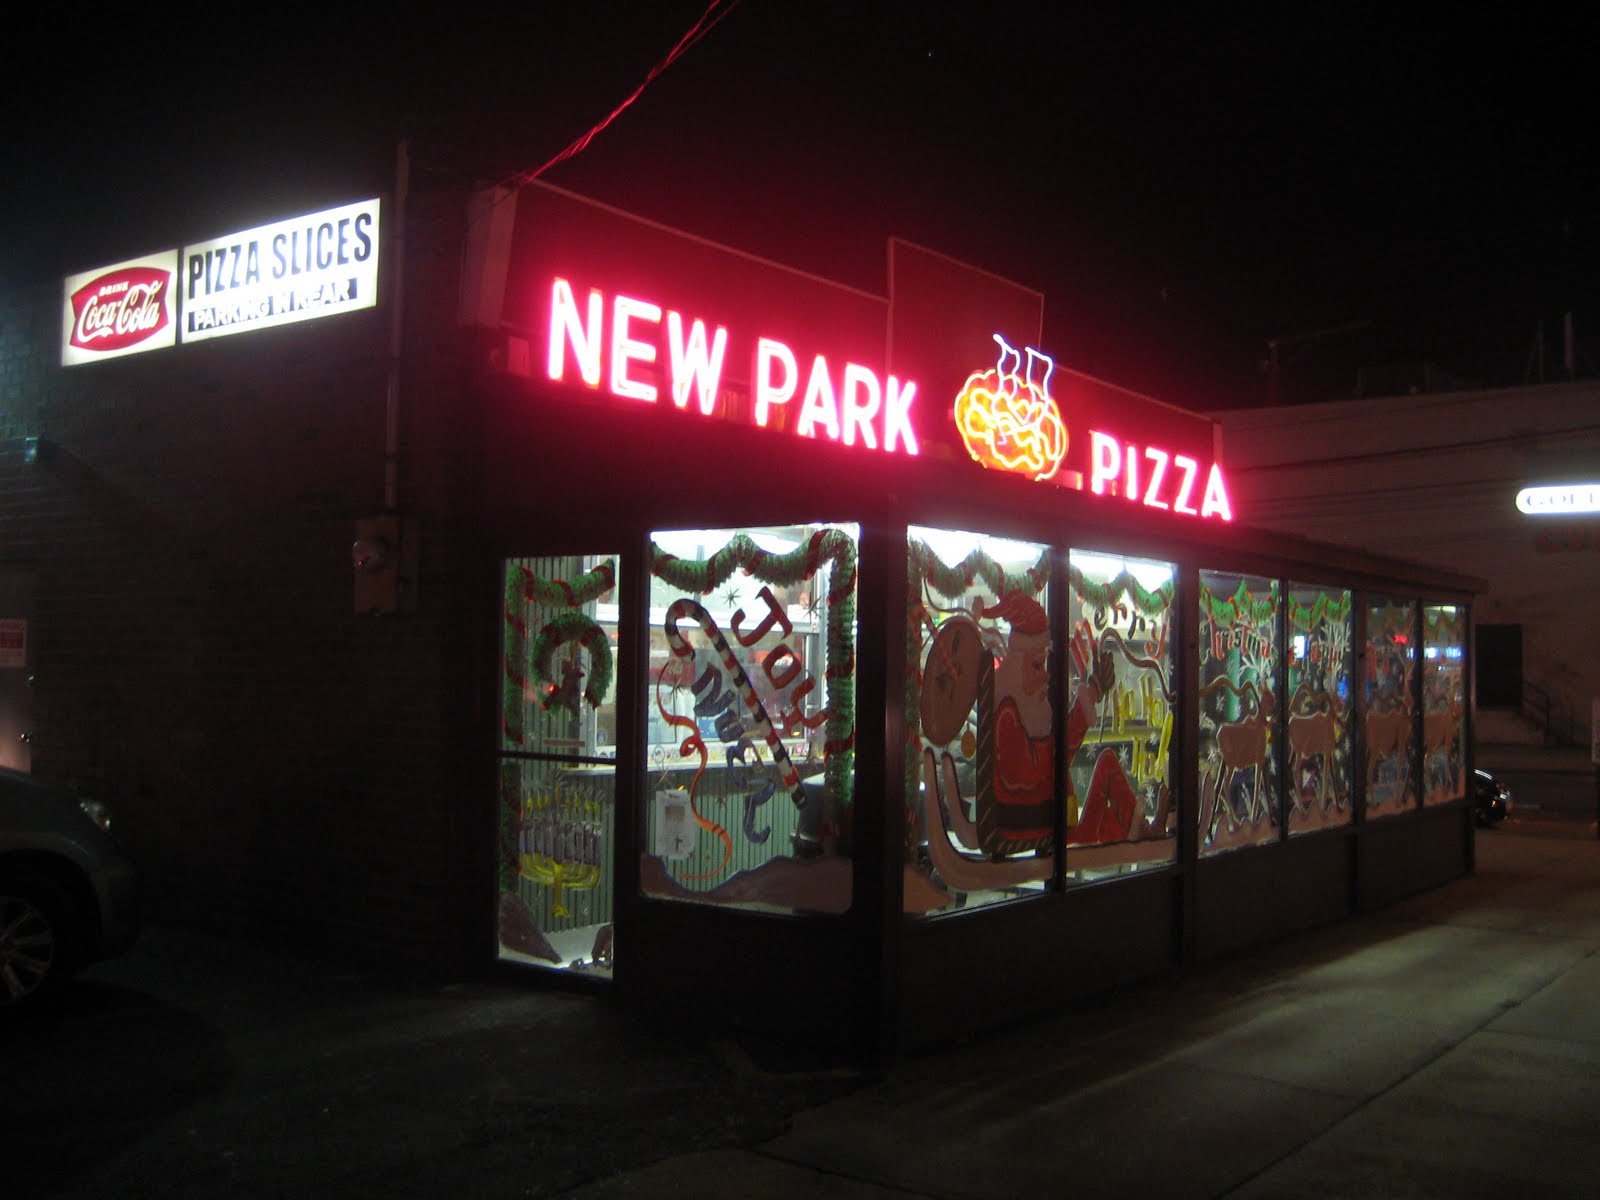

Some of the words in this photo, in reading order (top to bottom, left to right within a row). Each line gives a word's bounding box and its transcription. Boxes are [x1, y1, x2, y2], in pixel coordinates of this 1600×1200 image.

[188, 240, 260, 300] PIZZA
[272, 212, 372, 279] SLICES
[77, 280, 163, 343] Coca-Cola
[194, 294, 269, 330] PARKING
[548, 277, 728, 415] NEW
[756, 338, 920, 456] PARK
[1089, 429, 1232, 521] PIZZA
